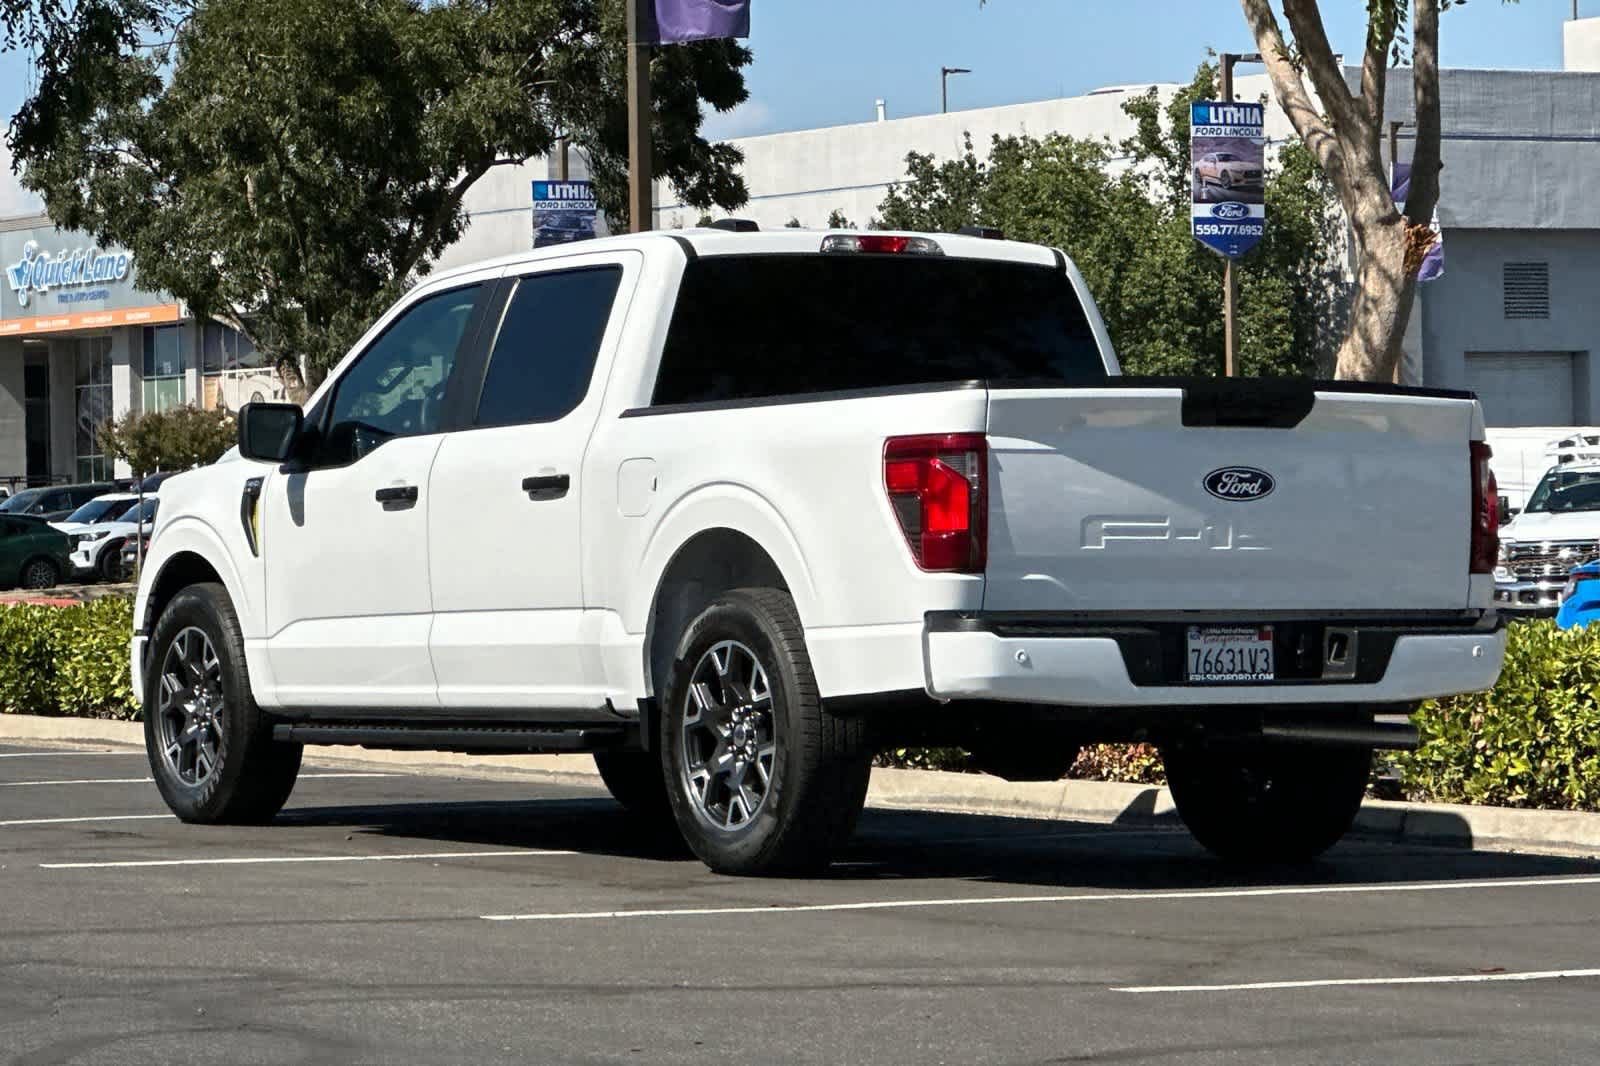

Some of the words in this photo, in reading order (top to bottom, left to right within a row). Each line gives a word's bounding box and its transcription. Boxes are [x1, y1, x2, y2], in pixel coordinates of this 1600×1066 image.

[1209, 106, 1262, 125] LITHIA
[1195, 127, 1222, 136] FORD
[1223, 128, 1262, 137] LINCOLN
[535, 201, 559, 209] FORD
[560, 201, 595, 209] LINCOLN
[1218, 204, 1244, 217] Ford
[1195, 224, 1264, 236] 559.777.6952
[1217, 471, 1263, 495] Ford
[1191, 647, 1271, 675] 76631V3
